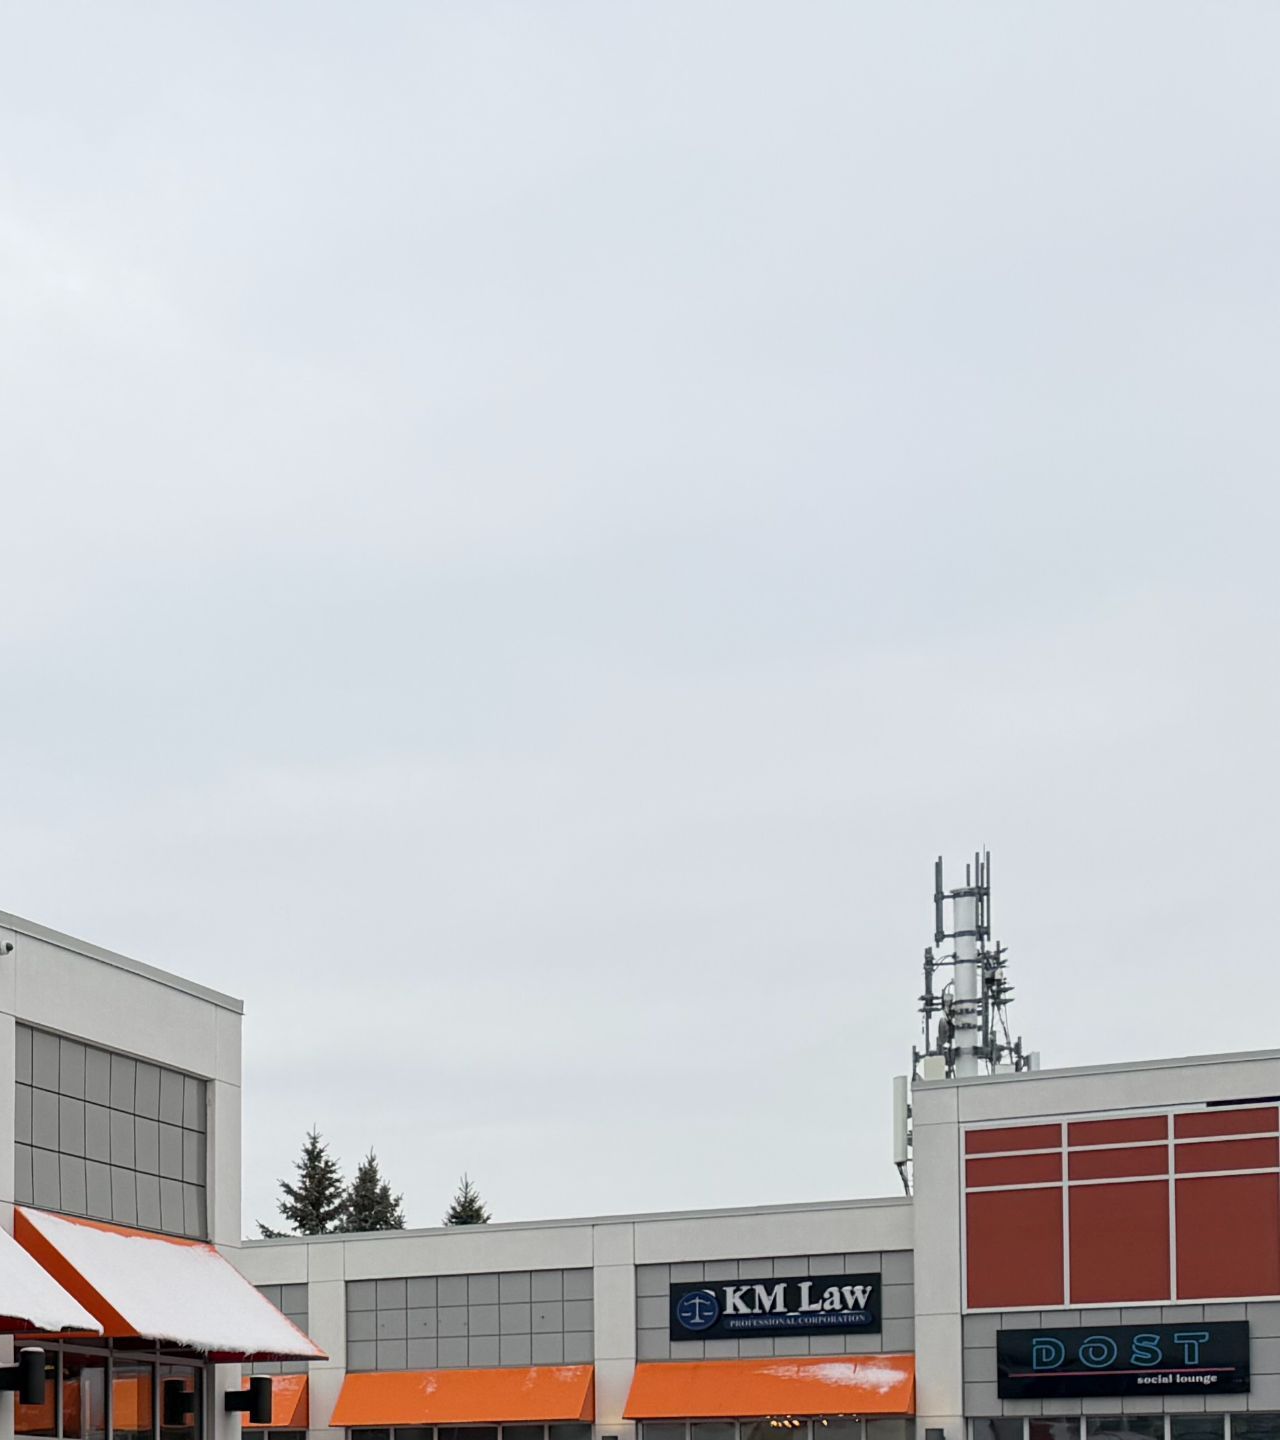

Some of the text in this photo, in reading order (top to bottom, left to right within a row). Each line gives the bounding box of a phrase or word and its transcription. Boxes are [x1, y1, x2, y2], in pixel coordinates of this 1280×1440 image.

[722, 1281, 873, 1315] KM Law
[729, 1314, 866, 1328] PROFESSIONAL CORPORATION
[1032, 1331, 1210, 1371] DOST
[1137, 1373, 1218, 1386] social lounge
